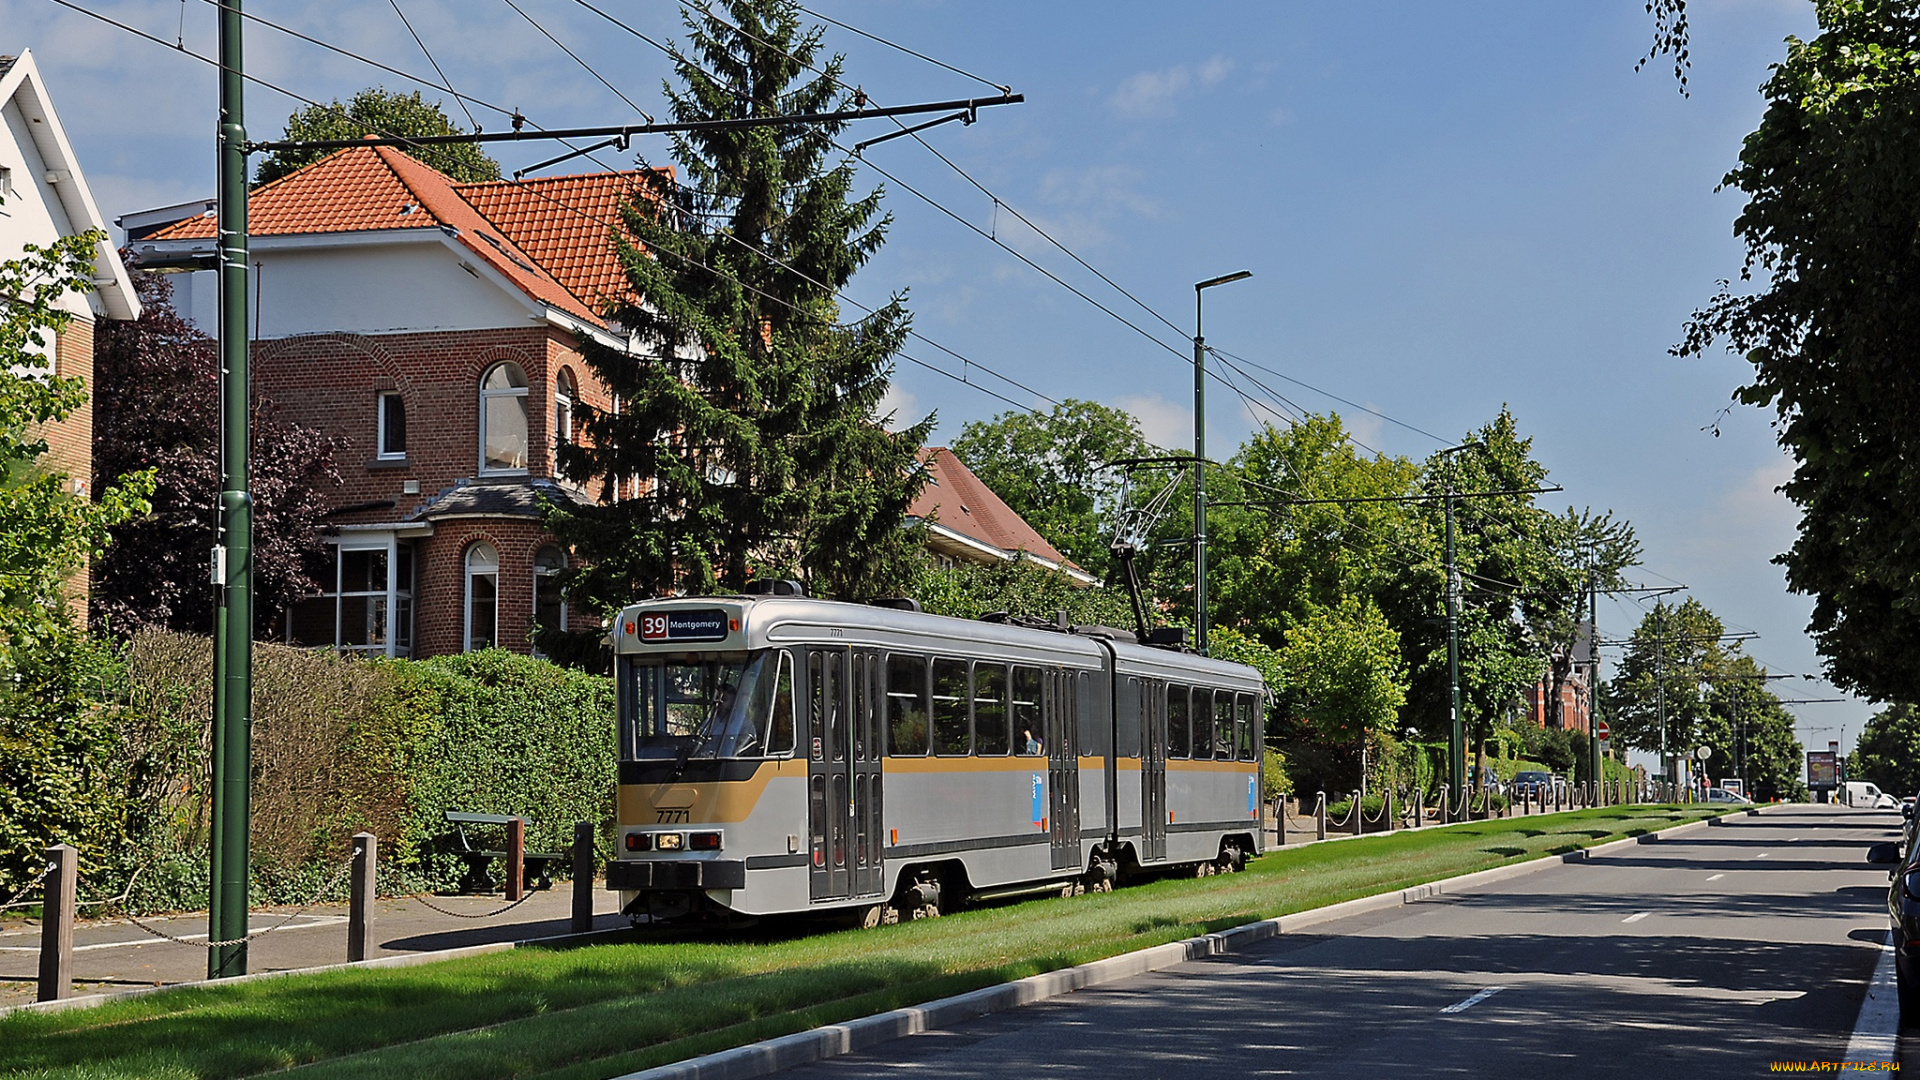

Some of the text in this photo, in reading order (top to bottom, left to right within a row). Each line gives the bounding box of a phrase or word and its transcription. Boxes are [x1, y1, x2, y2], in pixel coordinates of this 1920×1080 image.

[644, 617, 720, 634] 39 Montgomery
[830, 628, 843, 637] 7771
[656, 810, 690, 824] 7771
